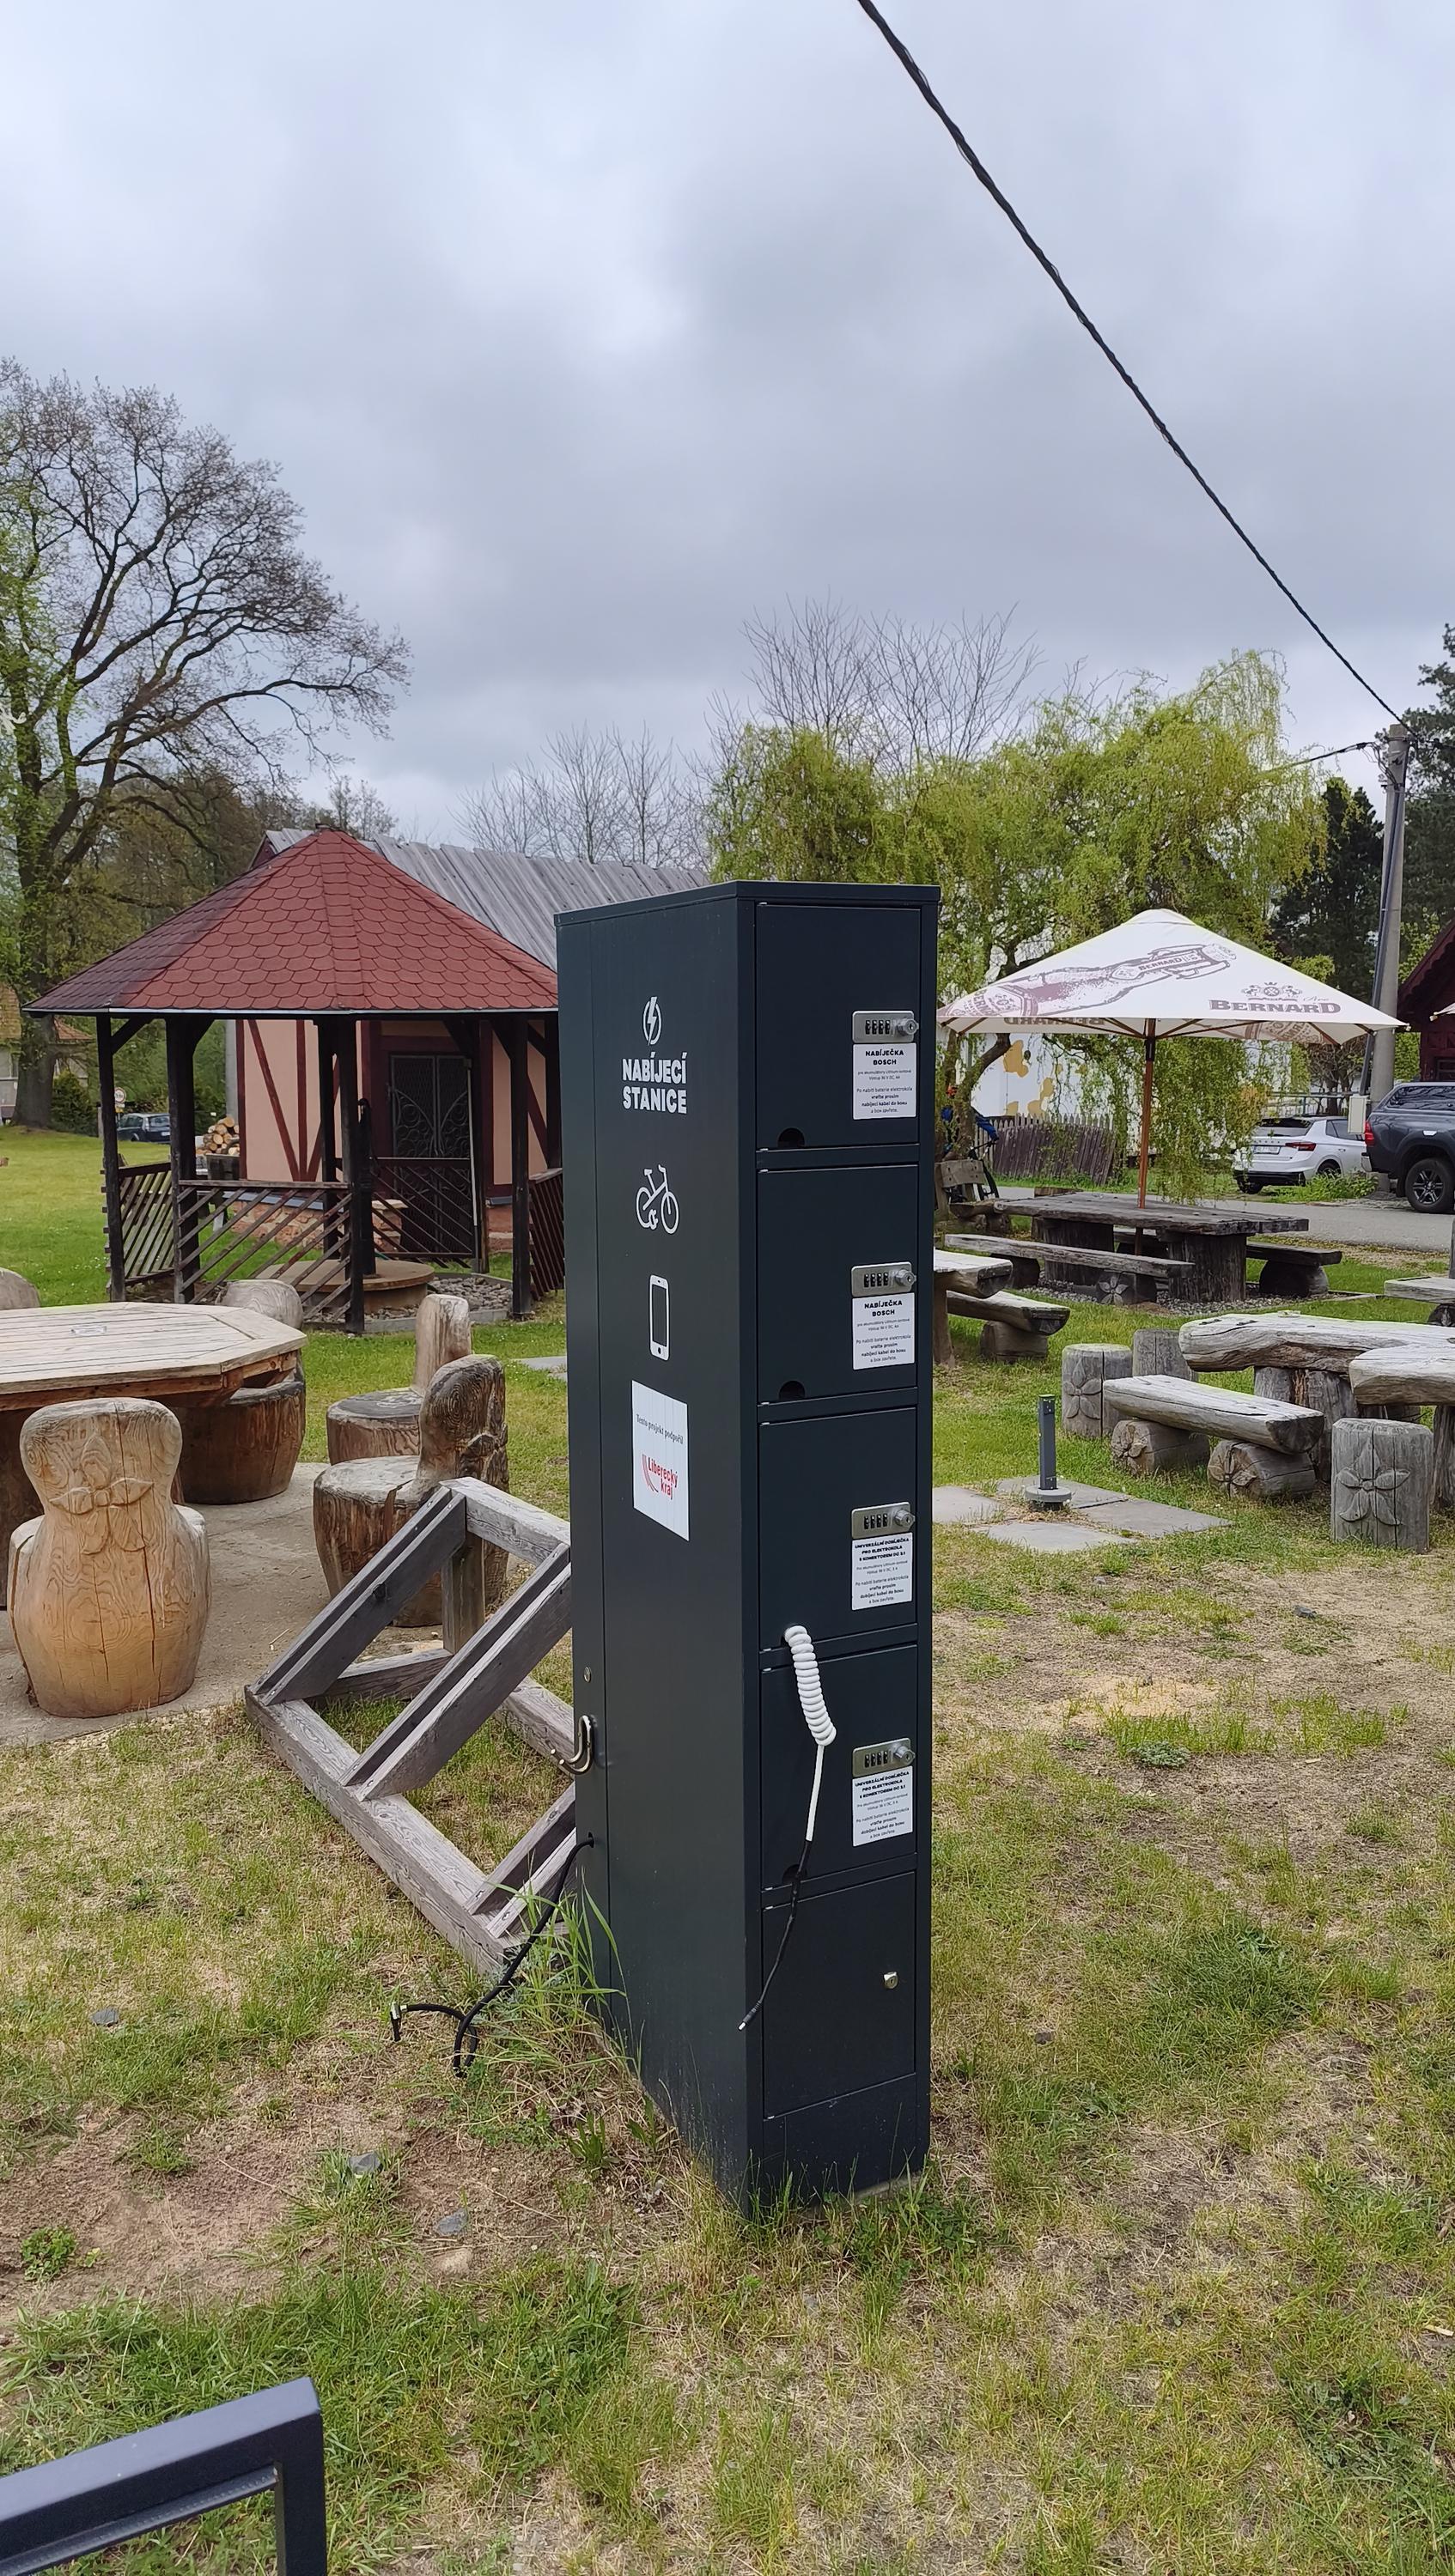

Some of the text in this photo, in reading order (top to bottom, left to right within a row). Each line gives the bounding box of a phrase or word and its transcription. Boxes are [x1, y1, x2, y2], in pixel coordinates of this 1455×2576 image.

[1138, 957, 1182, 971] BERNARD
[1209, 999, 1341, 1014] BERNARD
[622, 1051, 687, 1084] NABÍJECÍ
[623, 1085, 687, 1114] STANICE
[865, 1300, 902, 1309] NABÍJEČKA
[636, 1414, 684, 1445] Tento projekt podpořil
[648, 1457, 679, 1488] Liberecký
[661, 1479, 673, 1500] kraj
